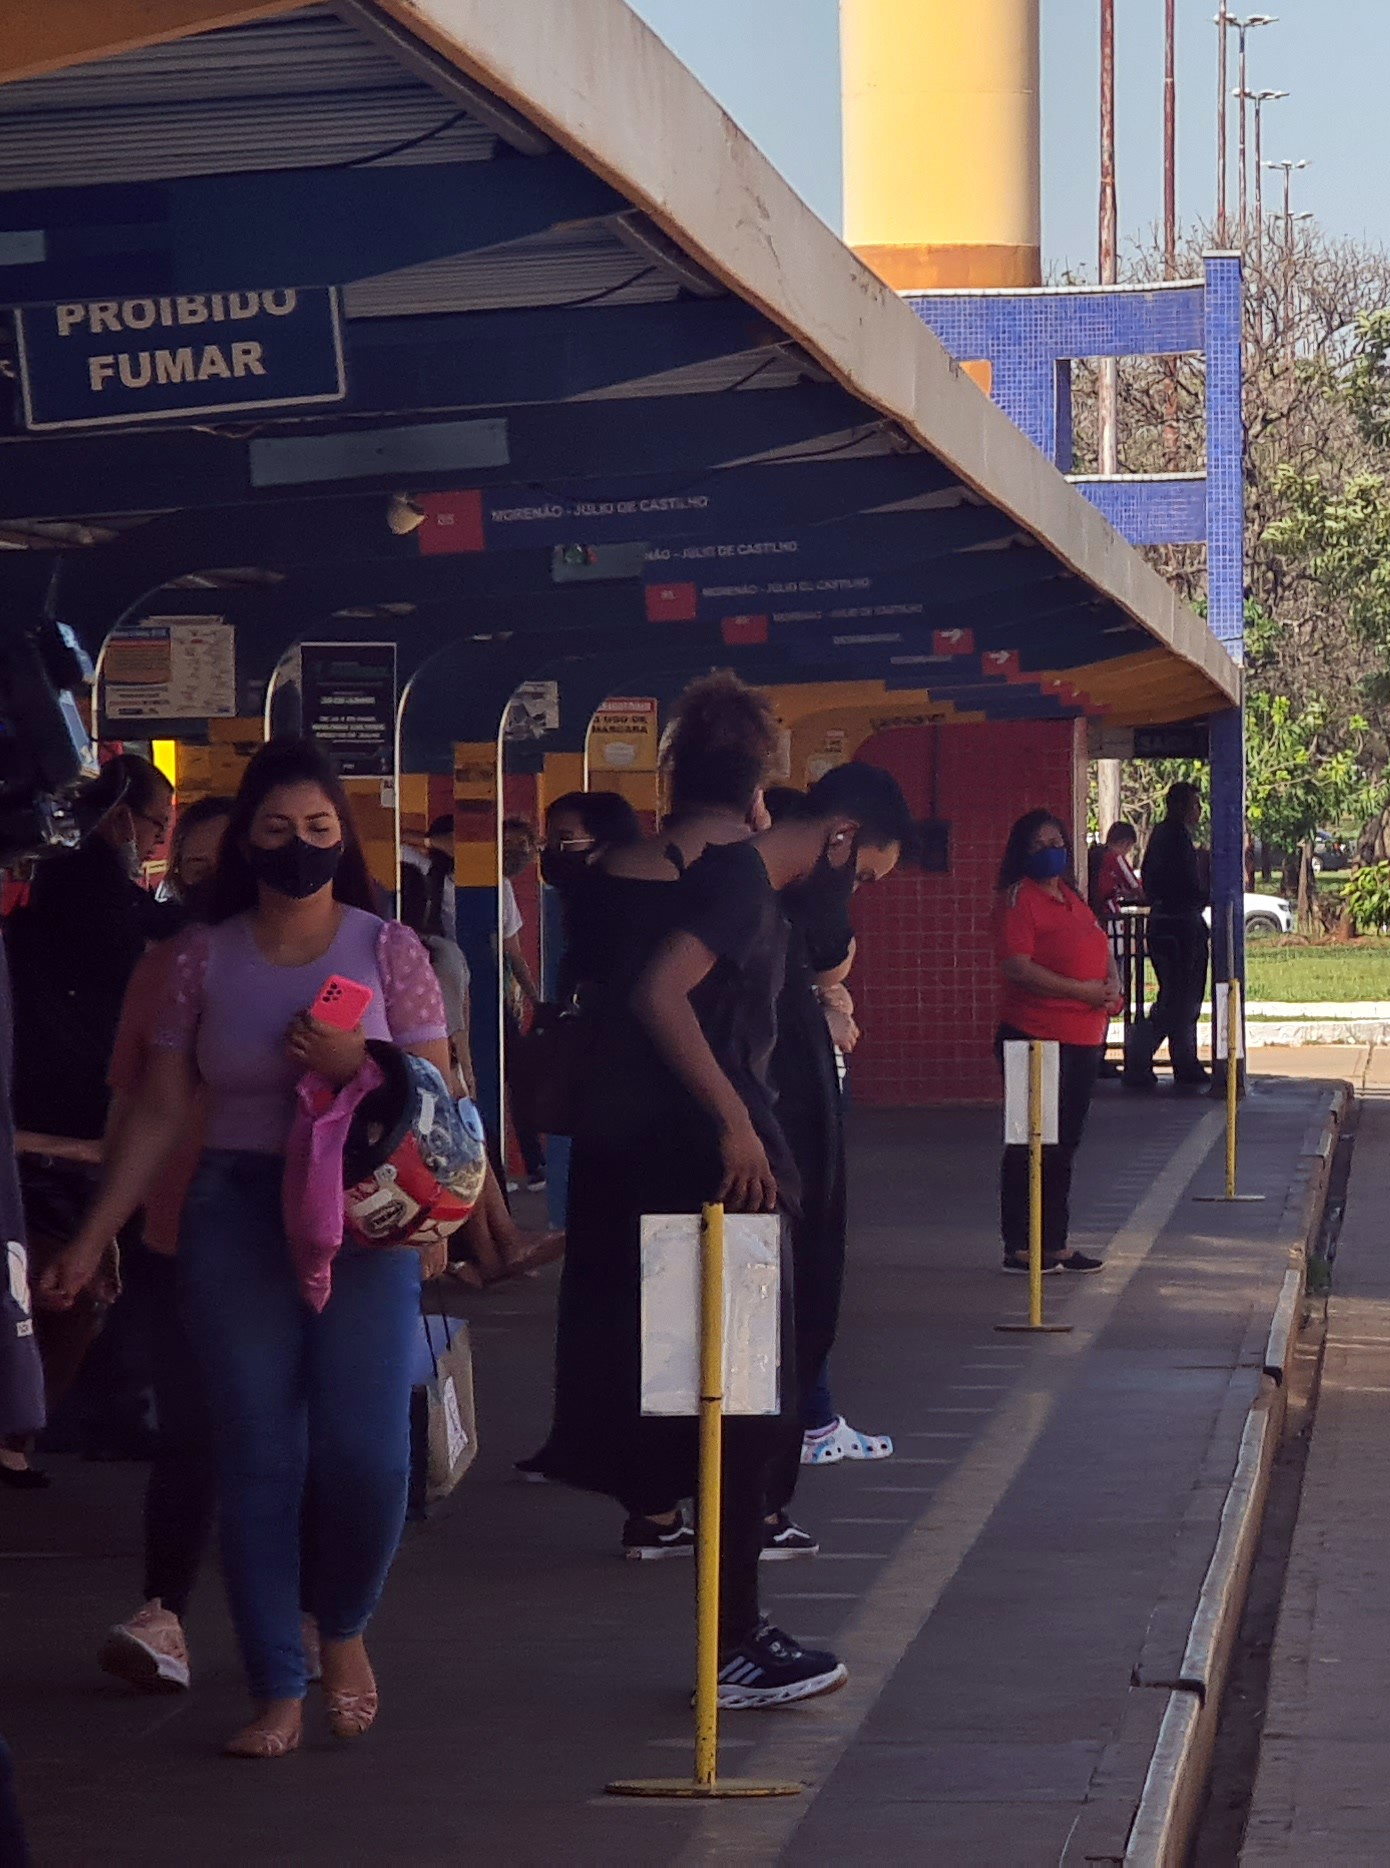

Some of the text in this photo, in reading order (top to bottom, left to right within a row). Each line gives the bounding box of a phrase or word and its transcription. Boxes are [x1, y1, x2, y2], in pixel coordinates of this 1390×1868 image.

[56, 288, 297, 336] PROIBIDO
[89, 341, 267, 390] FUMAR
[491, 504, 563, 522] MORENÃO
[617, 500, 636, 514] DE
[639, 496, 709, 512] CASTILHO
[644, 548, 671, 561] NÃO
